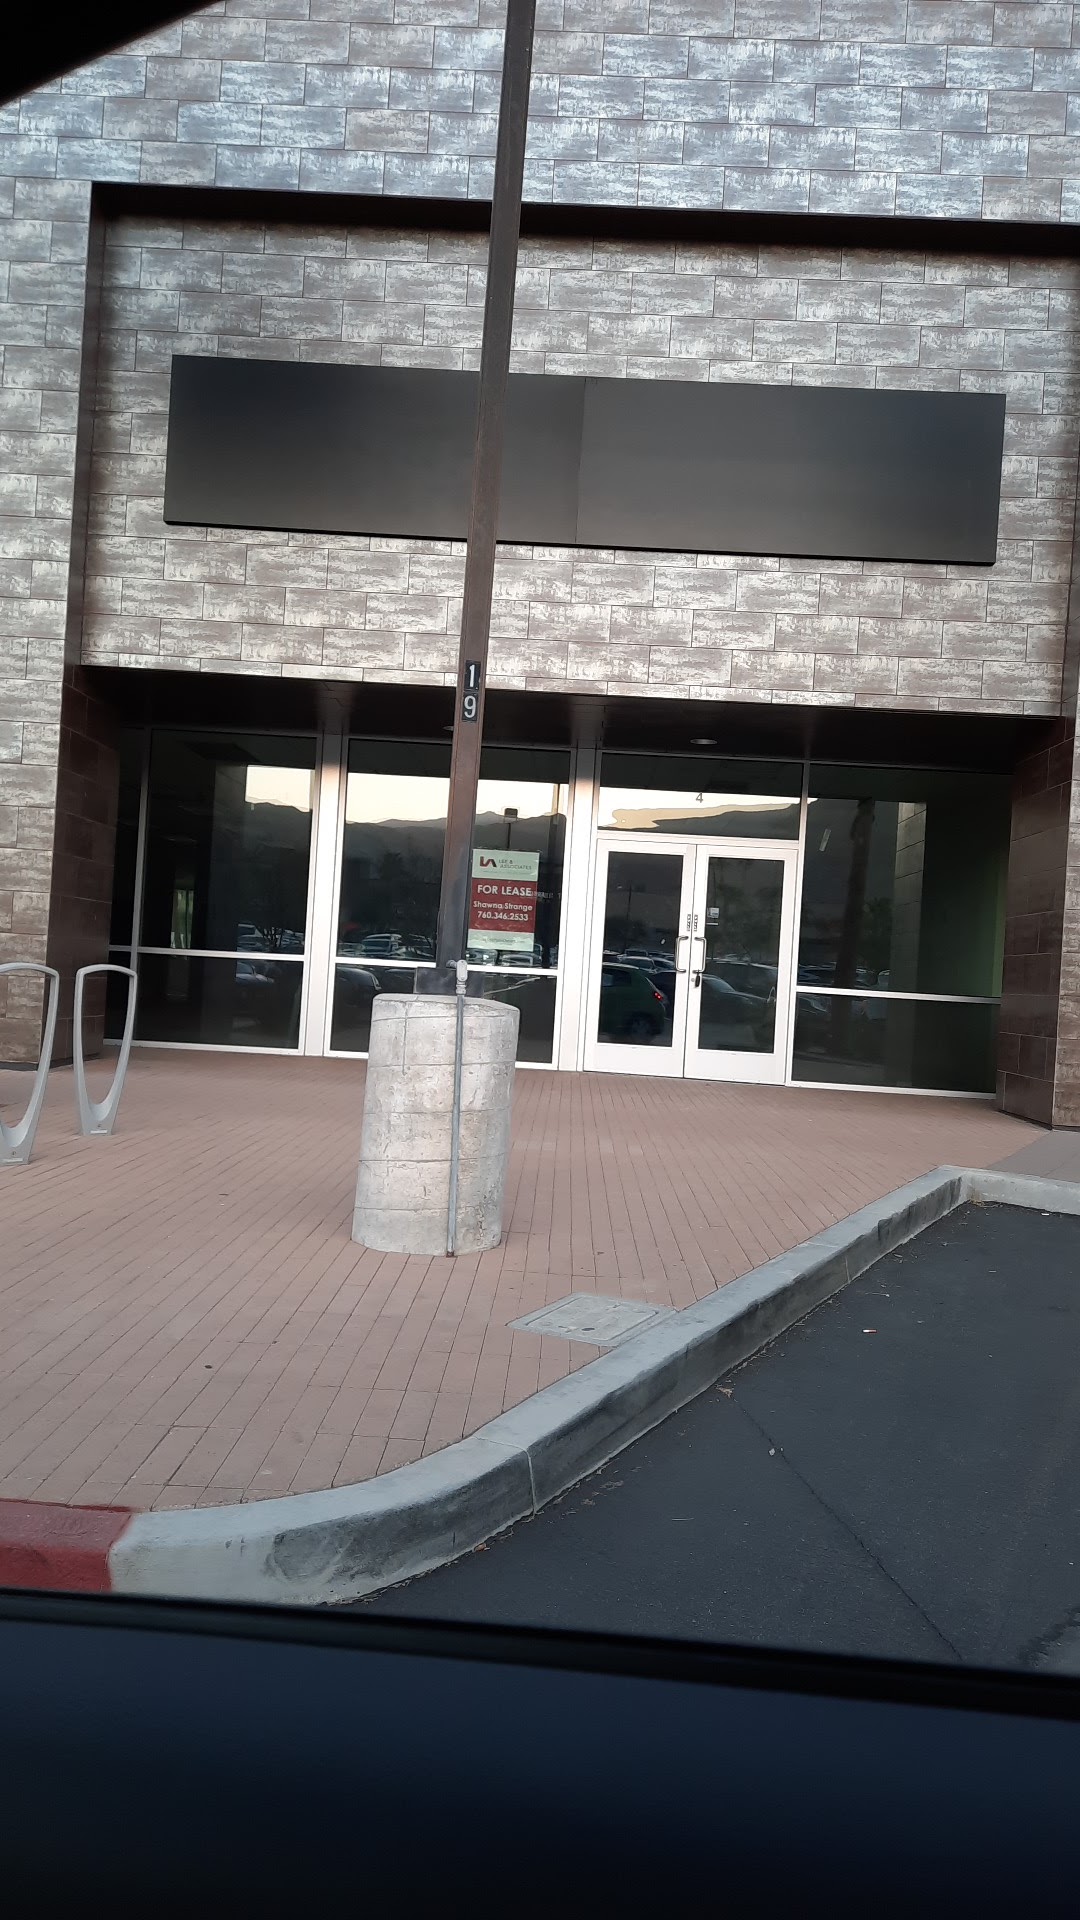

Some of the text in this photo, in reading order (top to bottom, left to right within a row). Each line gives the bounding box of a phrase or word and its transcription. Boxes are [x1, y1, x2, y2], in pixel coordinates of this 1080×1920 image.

[469, 664, 476, 688] 1
[464, 695, 477, 719] 9
[695, 791, 704, 804] 4
[477, 884, 498, 895] FOR
[501, 886, 532, 897] LEASE
[473, 900, 533, 911] Shawna Strange
[477, 911, 529, 921] 760.346.2533
